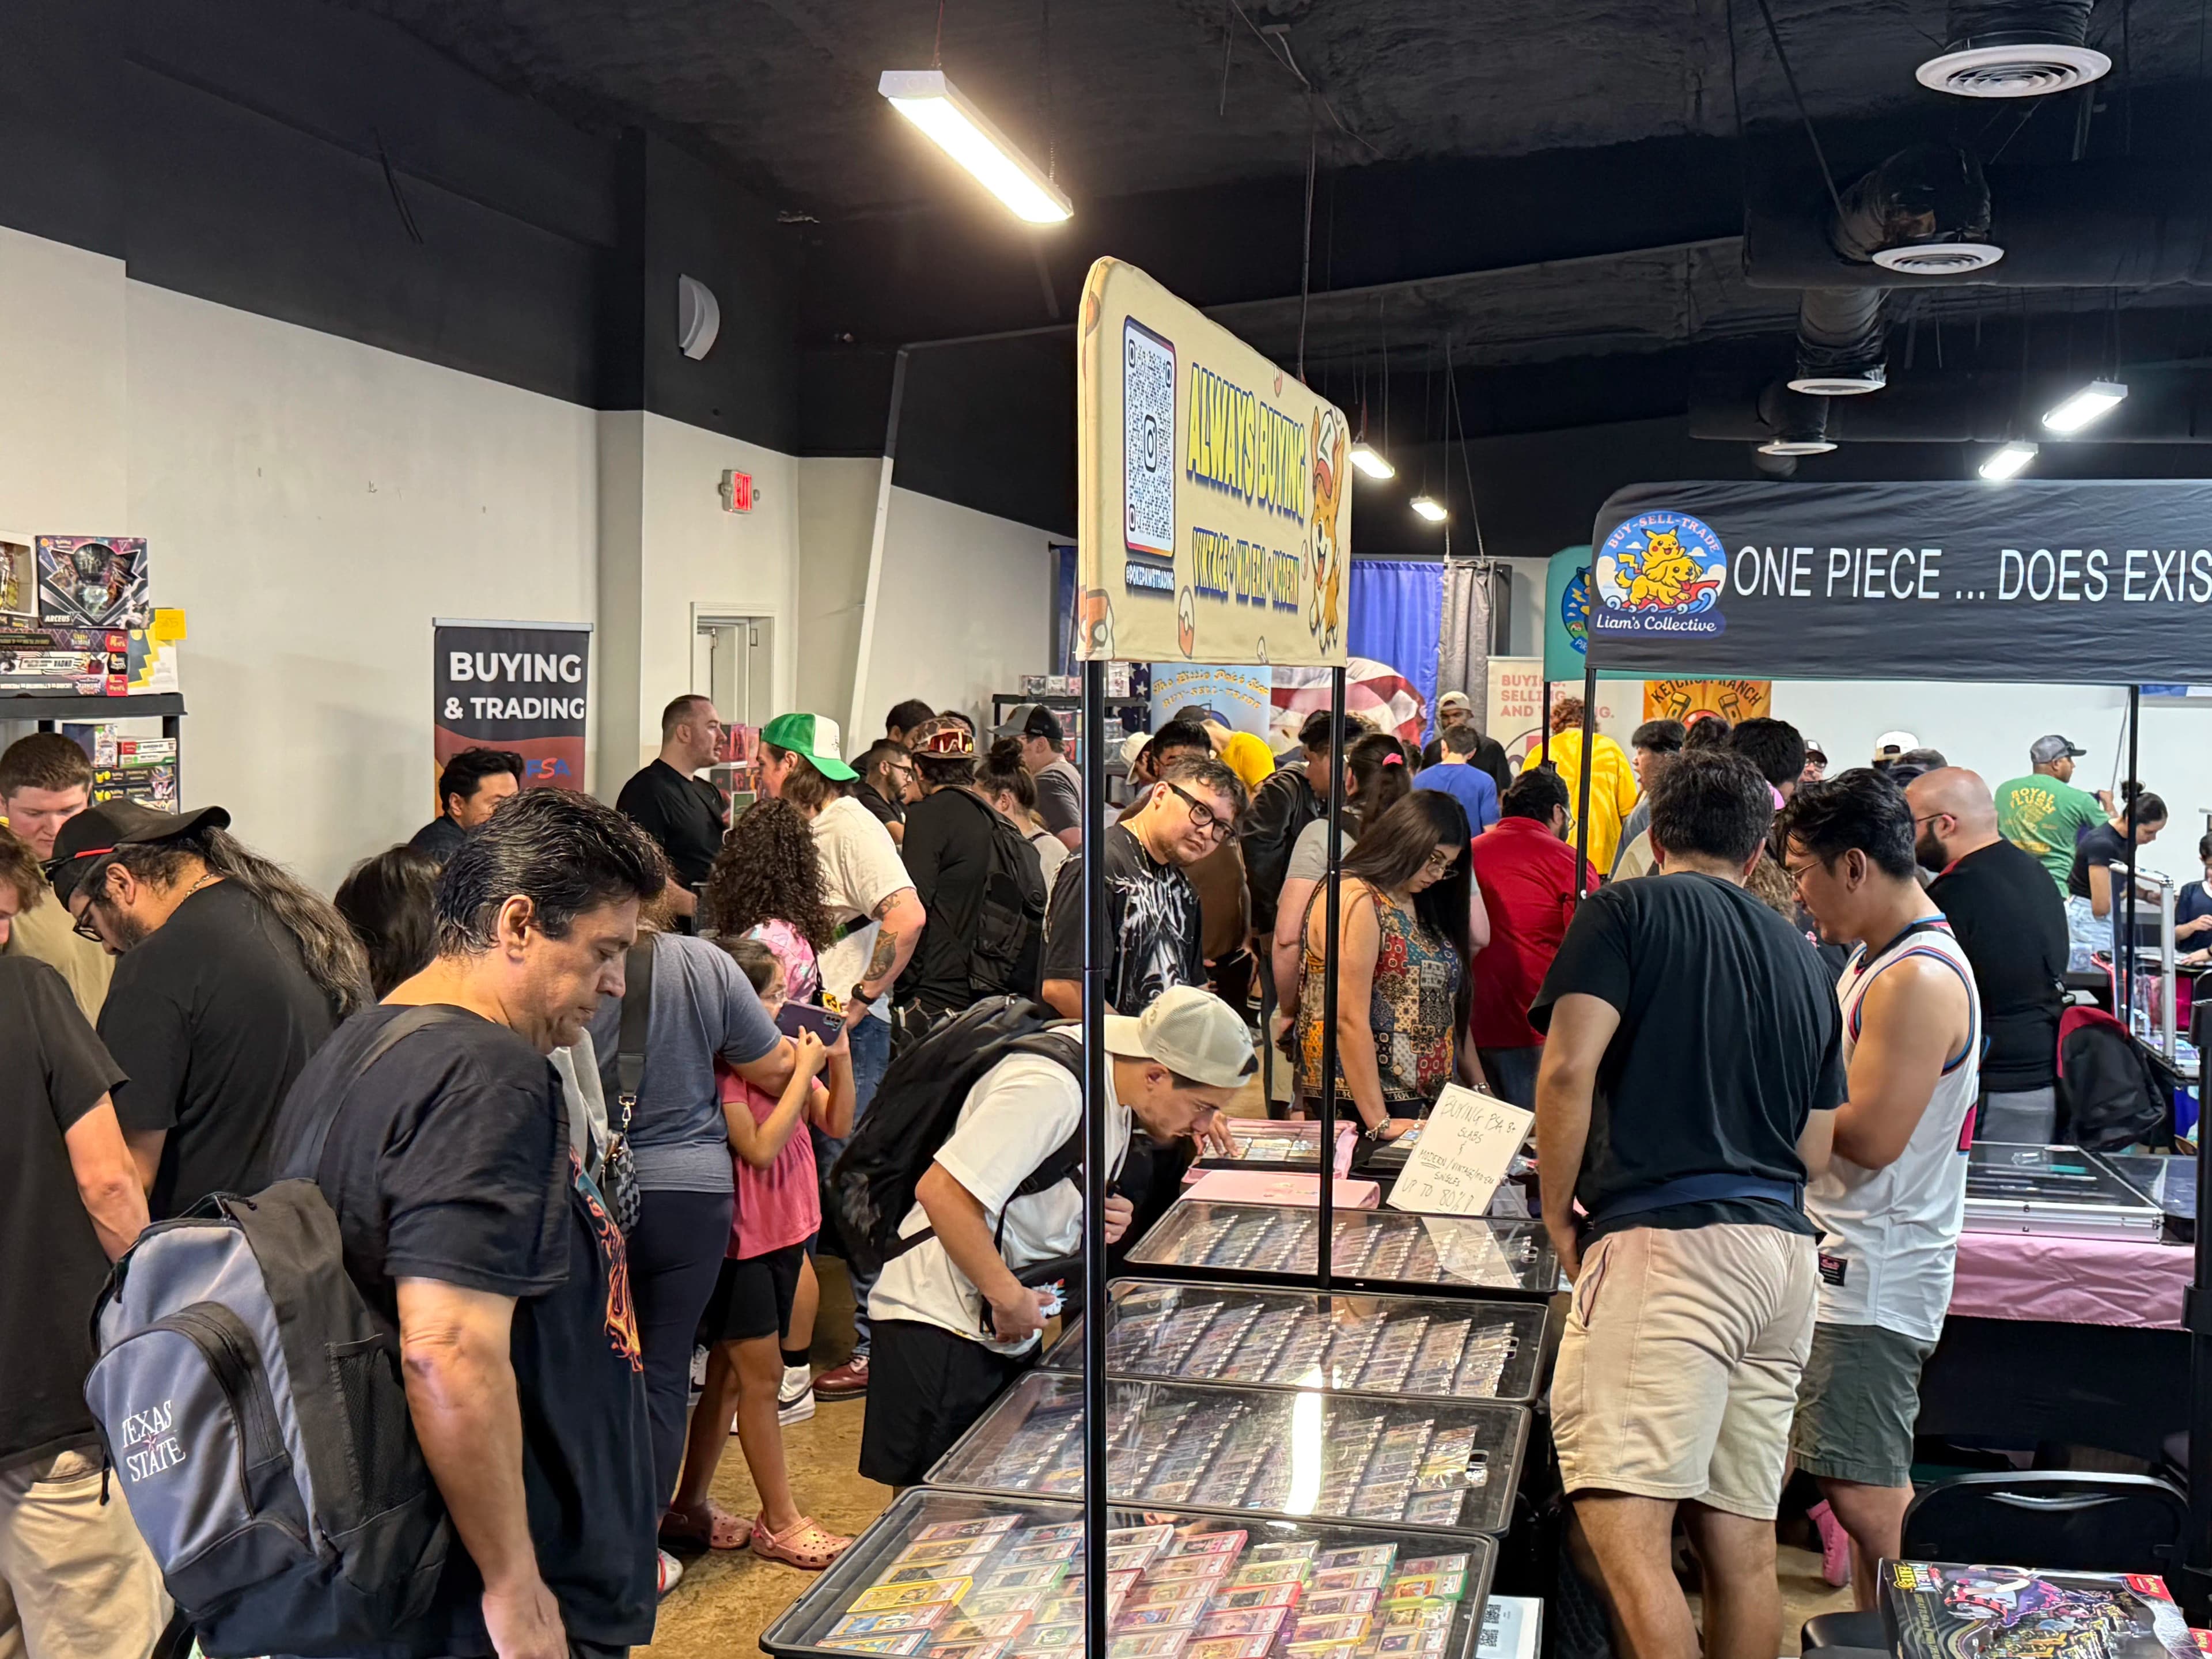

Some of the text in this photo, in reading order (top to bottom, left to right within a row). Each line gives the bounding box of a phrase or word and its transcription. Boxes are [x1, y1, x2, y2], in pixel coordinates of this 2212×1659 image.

[1187, 362, 1305, 524] ALWAYS BUYING
[1608, 514, 1721, 554] BUY-SELL-TRADE
[1193, 526, 1229, 594] VINTAGE
[1252, 544, 1266, 601] ERA
[1733, 545, 1814, 598] ONE
[1827, 547, 1942, 600] PIECE
[1998, 549, 2108, 601] DOES
[44, 615, 71, 623] ARCEUS
[1596, 614, 1717, 633] Liam's Collective
[450, 652, 582, 683] BUYING
[444, 697, 585, 719] & TRADING
[1500, 705, 1533, 717] AND
[526, 757, 572, 779] PSA
[2011, 787, 2055, 803] ROYAL
[1440, 1095, 1484, 1126] BUYING
[1457, 1127, 1484, 1144] SLABS
[1402, 1177, 1416, 1192] UP
[1420, 1183, 1433, 1197] TO
[1434, 1171, 1461, 1187] SINGLES
[122, 1400, 172, 1448] TEXAS
[126, 1437, 186, 1482] STATE
